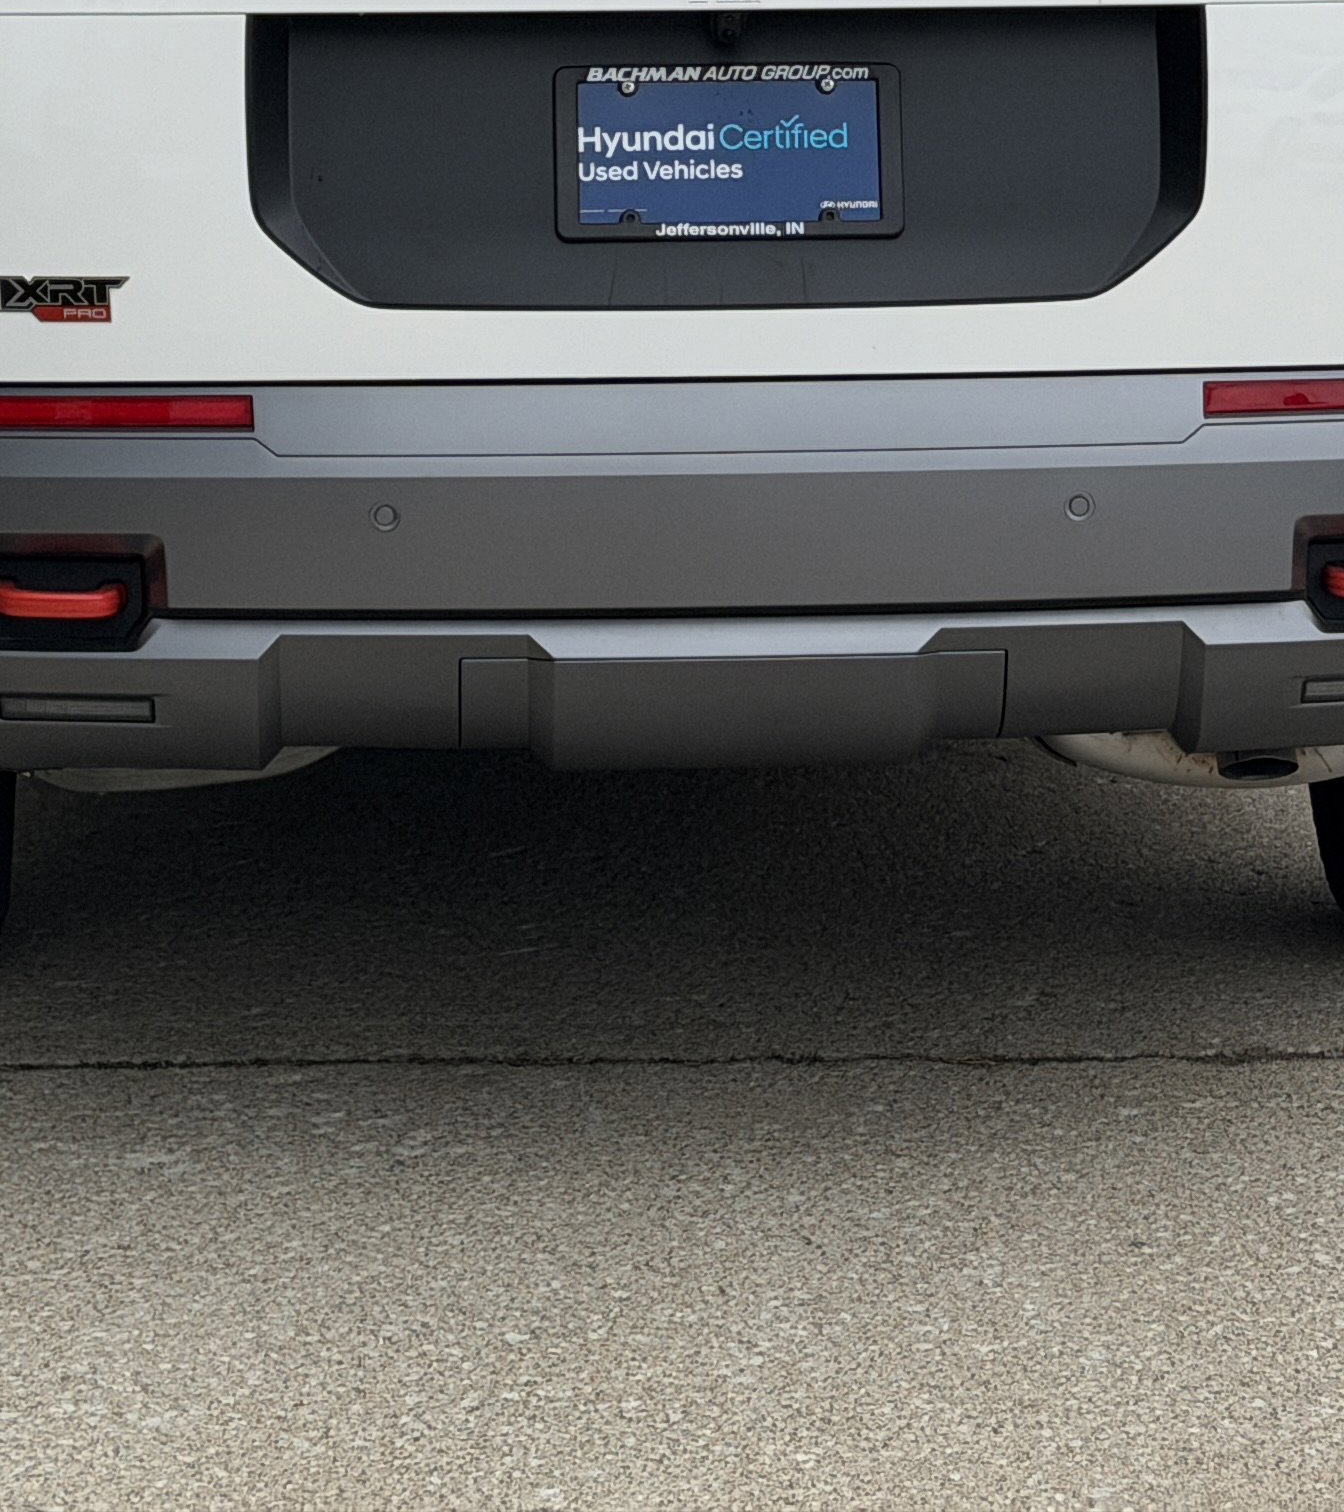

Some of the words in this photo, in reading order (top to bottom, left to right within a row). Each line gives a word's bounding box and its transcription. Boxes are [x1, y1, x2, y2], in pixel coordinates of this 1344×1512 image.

[587, 67, 702, 81] BACHMAN
[703, 66, 757, 80] AUTO
[760, 65, 869, 80] GROUP.com
[578, 124, 715, 158] Hyundai
[719, 115, 848, 150] Certified
[578, 162, 638, 182] Used
[642, 160, 743, 180] Vehicles
[837, 201, 879, 209] HYUNDAI
[656, 223, 781, 237] Jeffersonville,
[786, 222, 805, 235] IN
[63, 308, 107, 319] PRO
